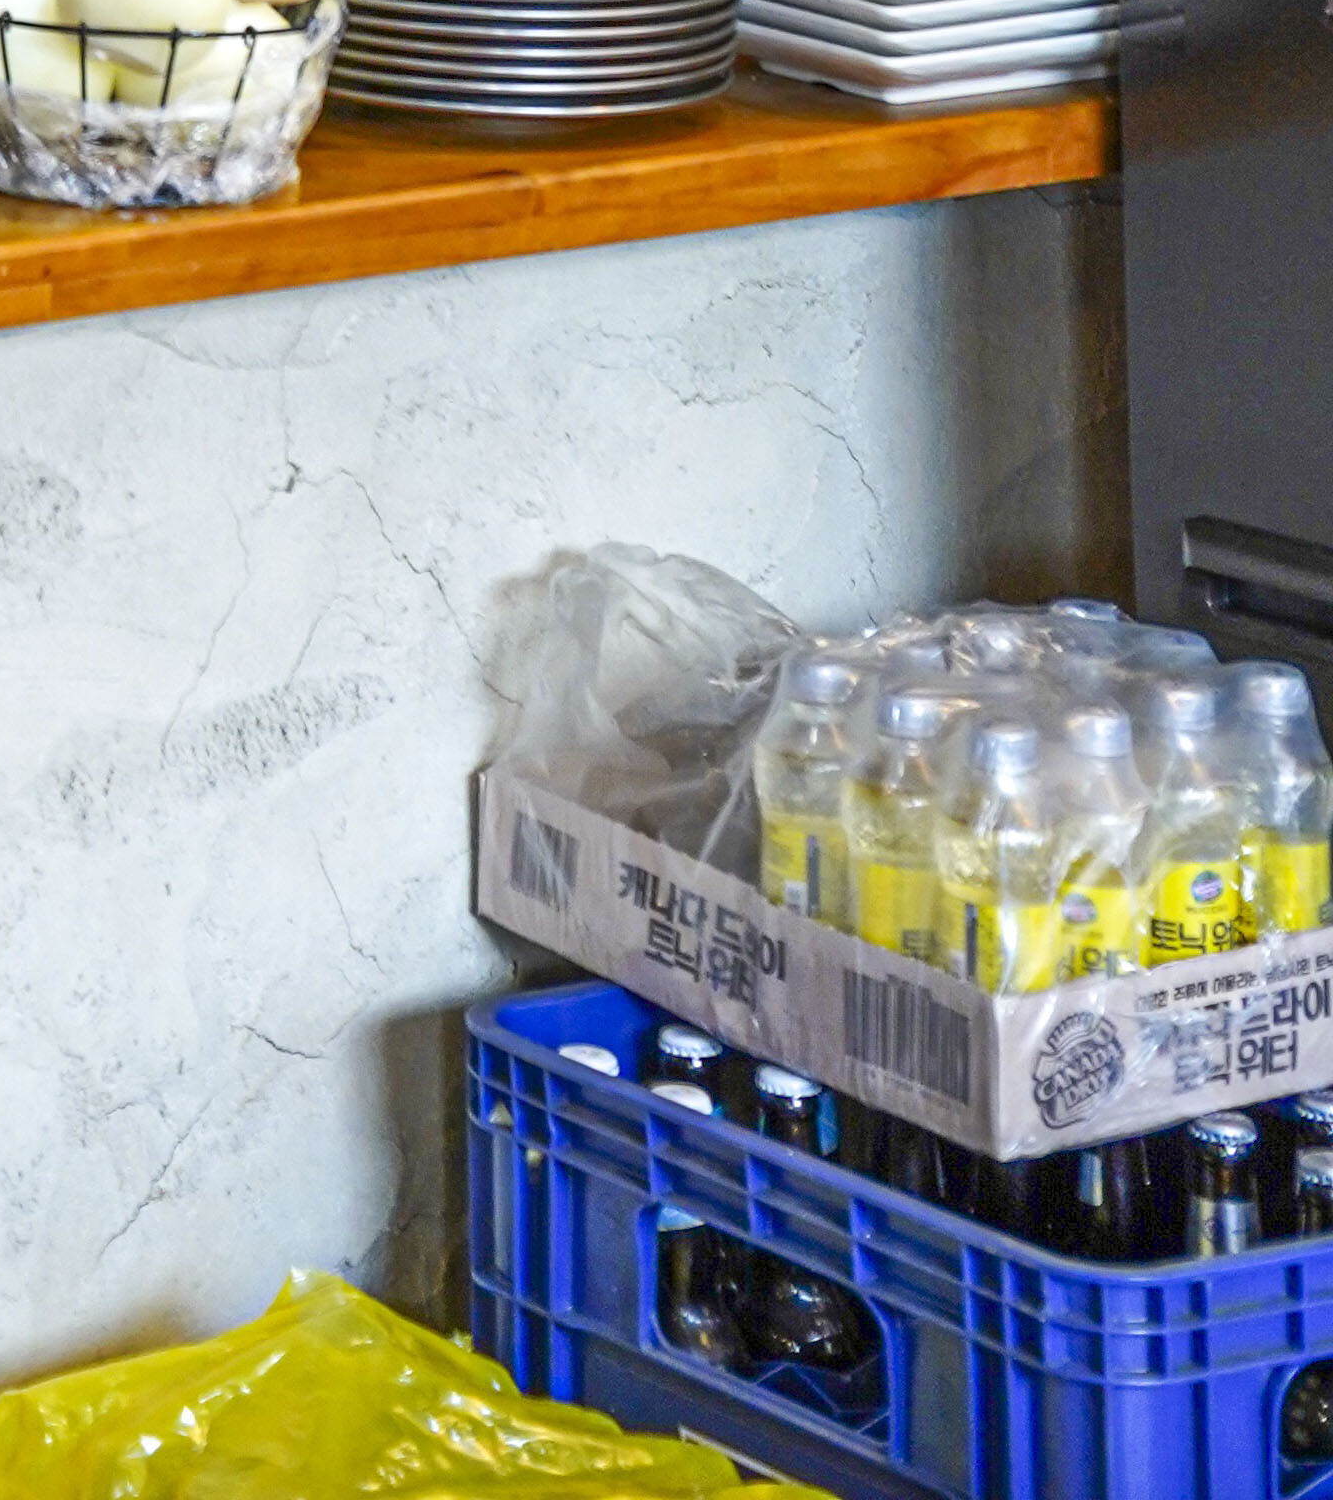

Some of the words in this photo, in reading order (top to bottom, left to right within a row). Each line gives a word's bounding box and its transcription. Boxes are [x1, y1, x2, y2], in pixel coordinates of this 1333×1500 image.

[619, 861, 708, 932] 캐나다
[645, 917, 703, 984] 토닉
[1238, 1031, 1298, 1081] 워터
